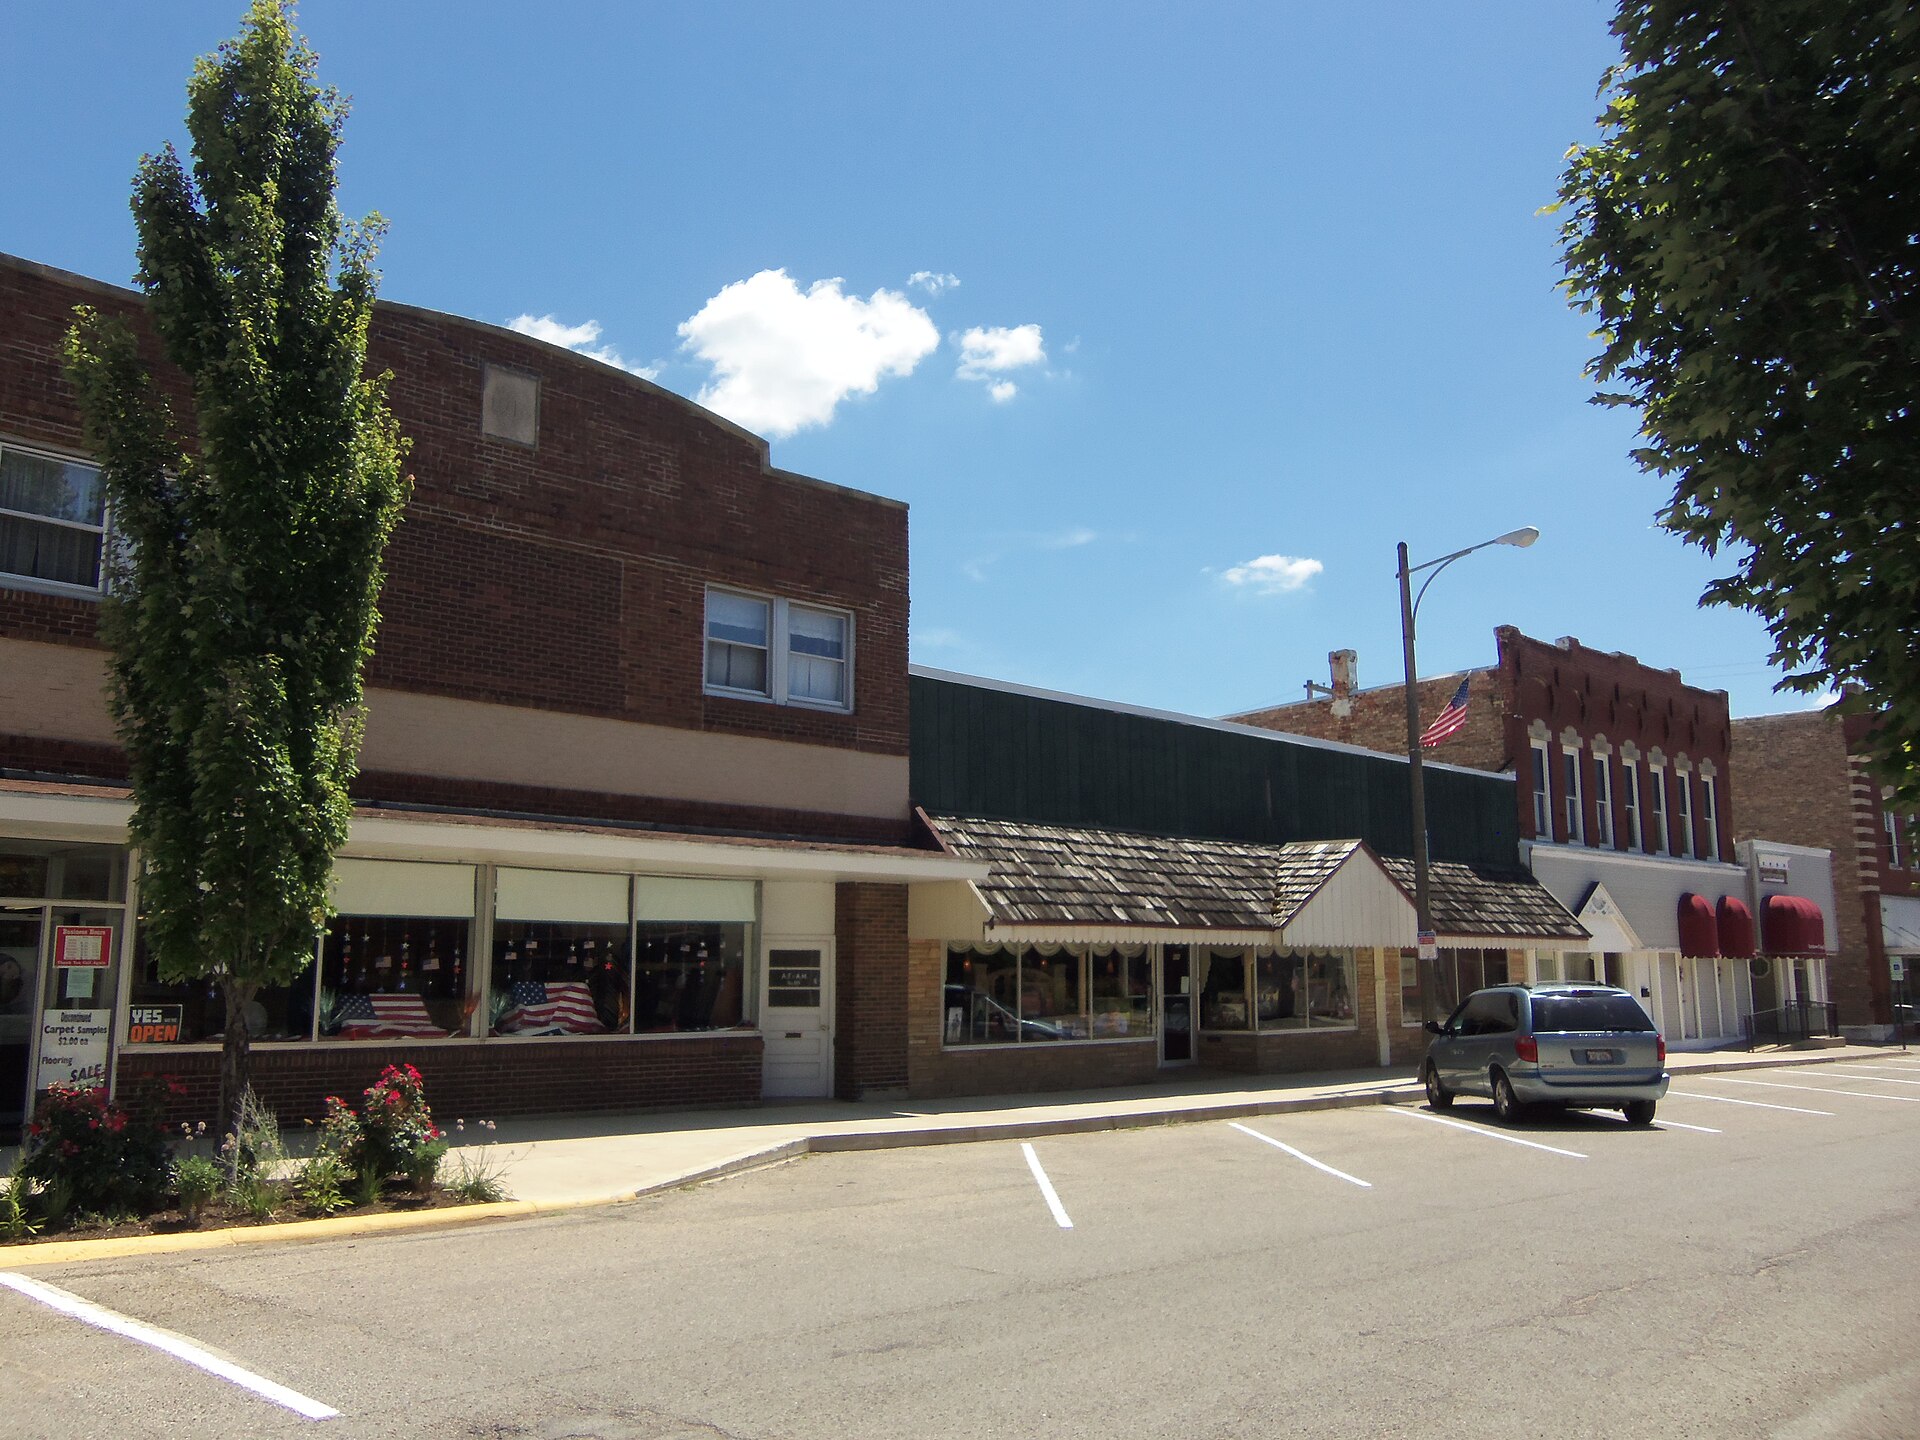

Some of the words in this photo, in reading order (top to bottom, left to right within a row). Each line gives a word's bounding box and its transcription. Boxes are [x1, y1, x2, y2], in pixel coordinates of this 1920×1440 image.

[131, 1009, 162, 1023] YES
[44, 1025, 75, 1036] Carpet
[76, 1025, 107, 1036] Samples
[131, 1024, 178, 1042] OPEN
[58, 1036, 79, 1046] $2.00
[41, 1056, 74, 1066] Flooring
[69, 1063, 102, 1083] SALE
